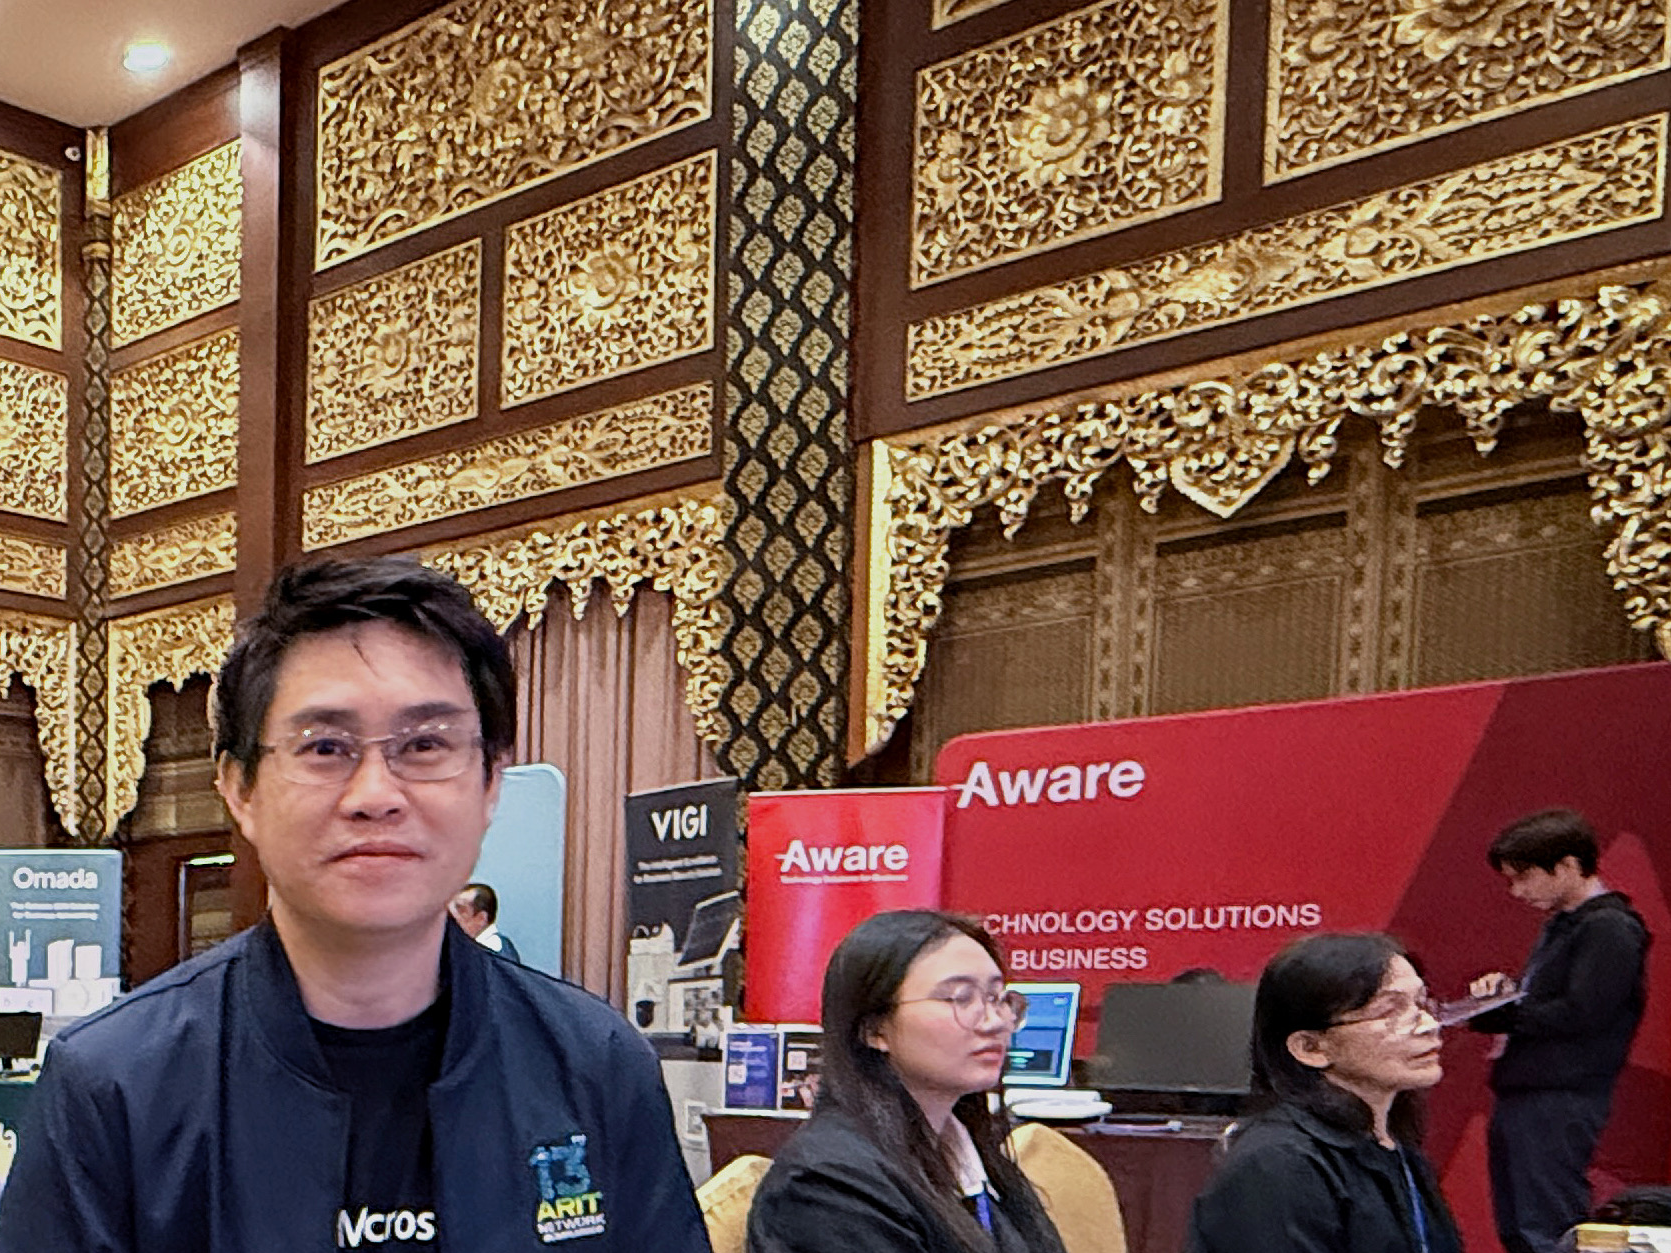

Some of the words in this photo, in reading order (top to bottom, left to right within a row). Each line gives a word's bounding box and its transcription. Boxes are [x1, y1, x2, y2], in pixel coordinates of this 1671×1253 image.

[951, 759, 1146, 808] Aware
[651, 804, 708, 843] VIGI
[775, 840, 909, 872] Aware
[13, 866, 98, 889] Omada
[1144, 903, 1323, 931] SOLUTIONS
[1010, 946, 1148, 971] BUSINESS
[537, 1192, 603, 1222] ARIT
